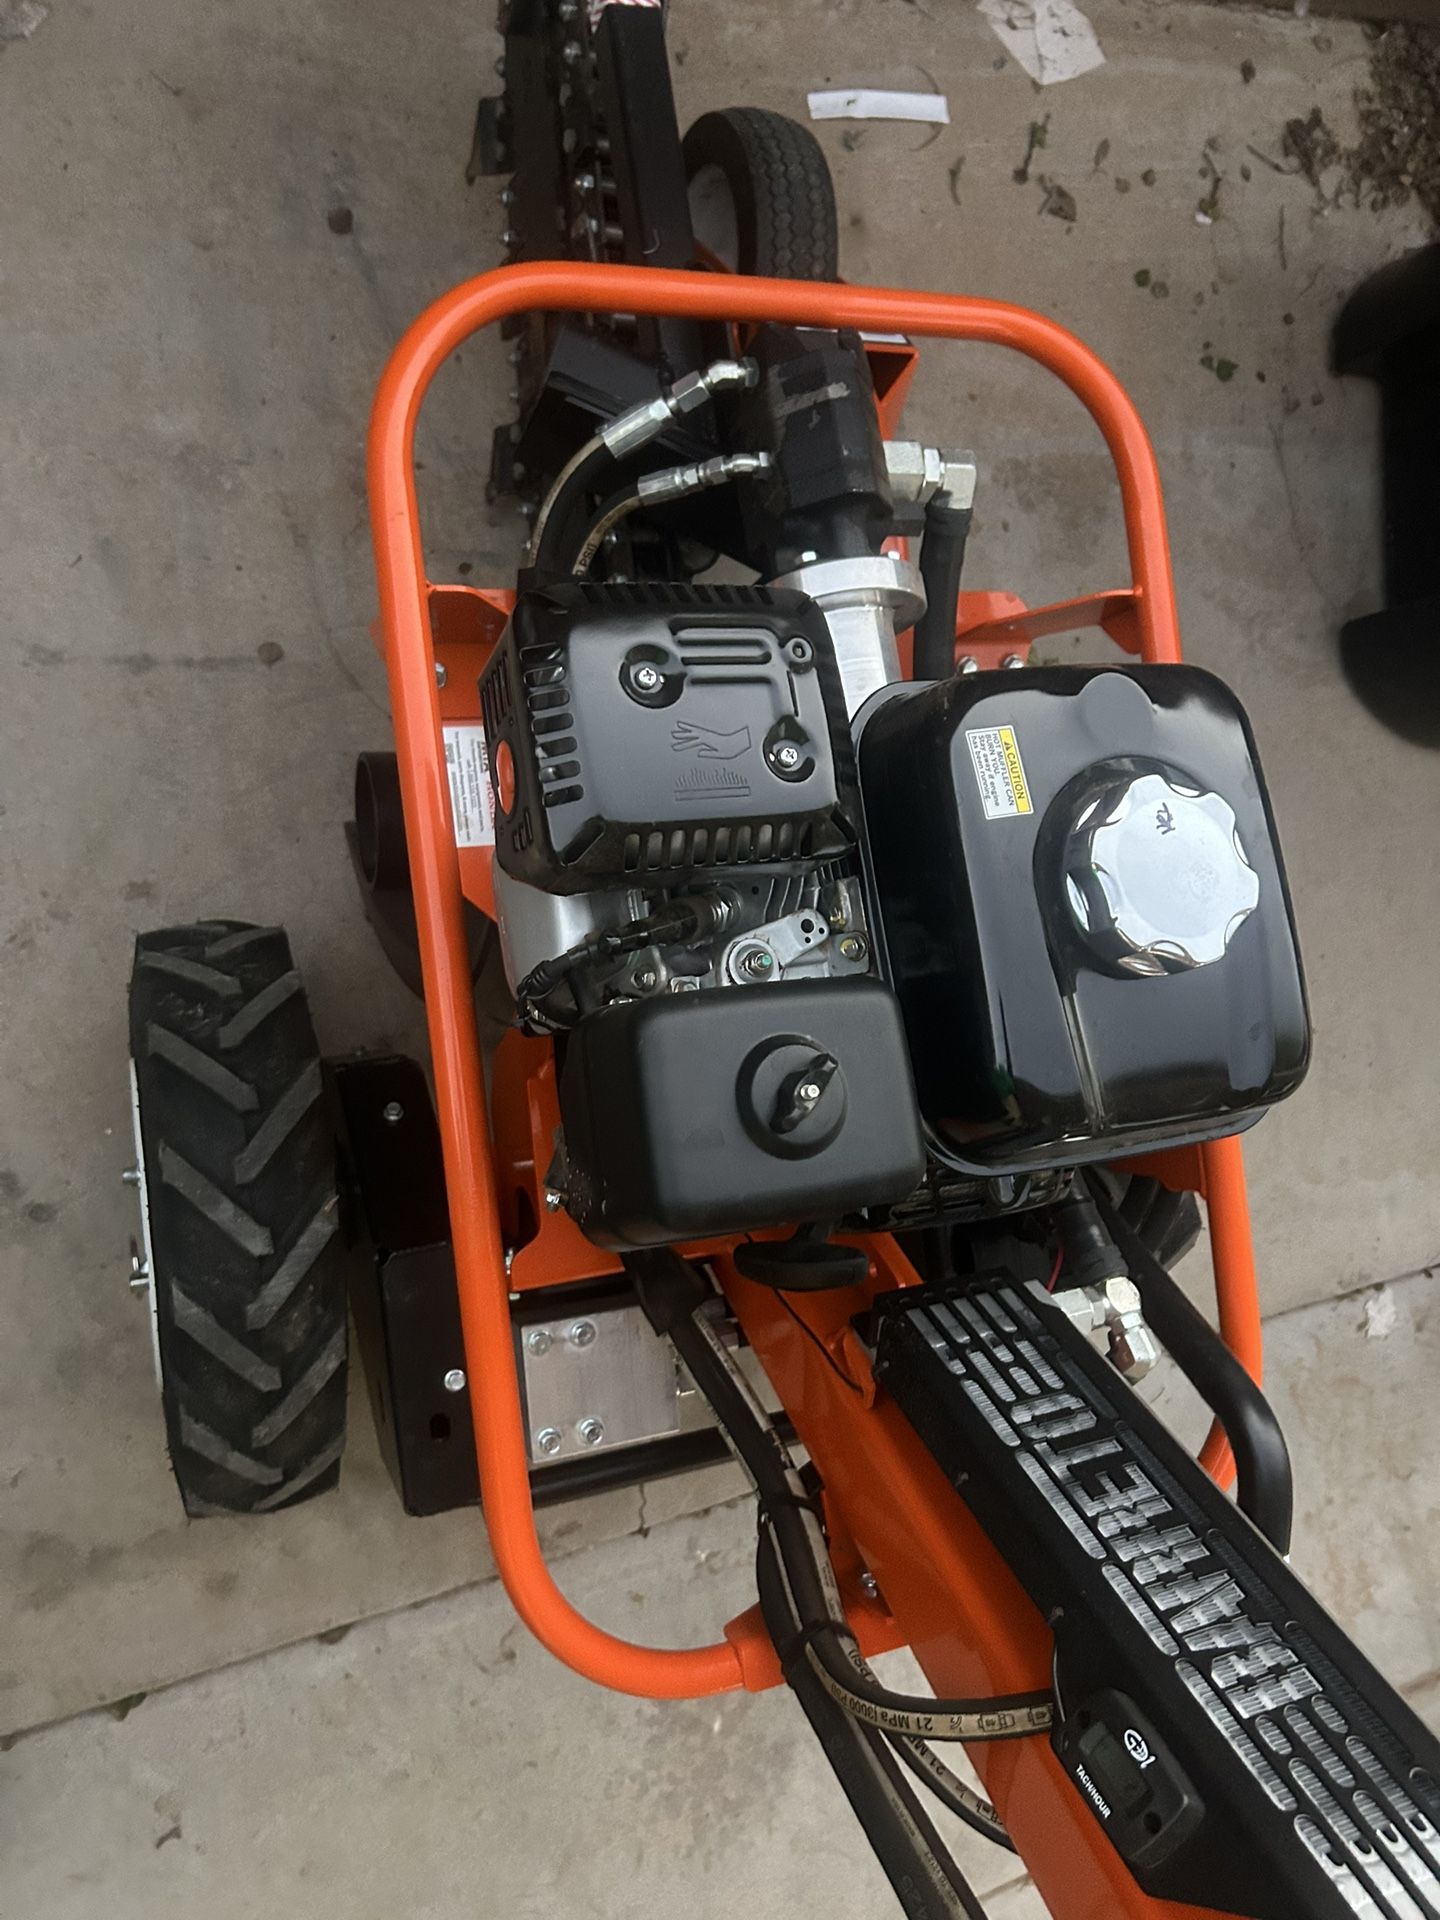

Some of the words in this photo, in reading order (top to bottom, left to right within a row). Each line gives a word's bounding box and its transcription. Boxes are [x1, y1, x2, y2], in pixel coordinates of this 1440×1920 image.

[975, 750, 984, 769] been
[984, 734, 995, 756] BURN
[978, 735, 987, 751] Stay
[983, 753, 992, 772] away
[989, 781, 1000, 807] engine
[992, 733, 1002, 748] HOT
[997, 751, 1011, 787] MUFFLER
[1005, 789, 1015, 806] CAN
[1007, 752, 1025, 799] CAUTION
[1010, 1393, 1323, 1719] BARRETO
[880, 1713, 910, 1730] MPa
[916, 1717, 934, 1732] 21
[929, 1757, 946, 1776] 21
[1076, 1763, 1112, 1819] TACH/HOUR
